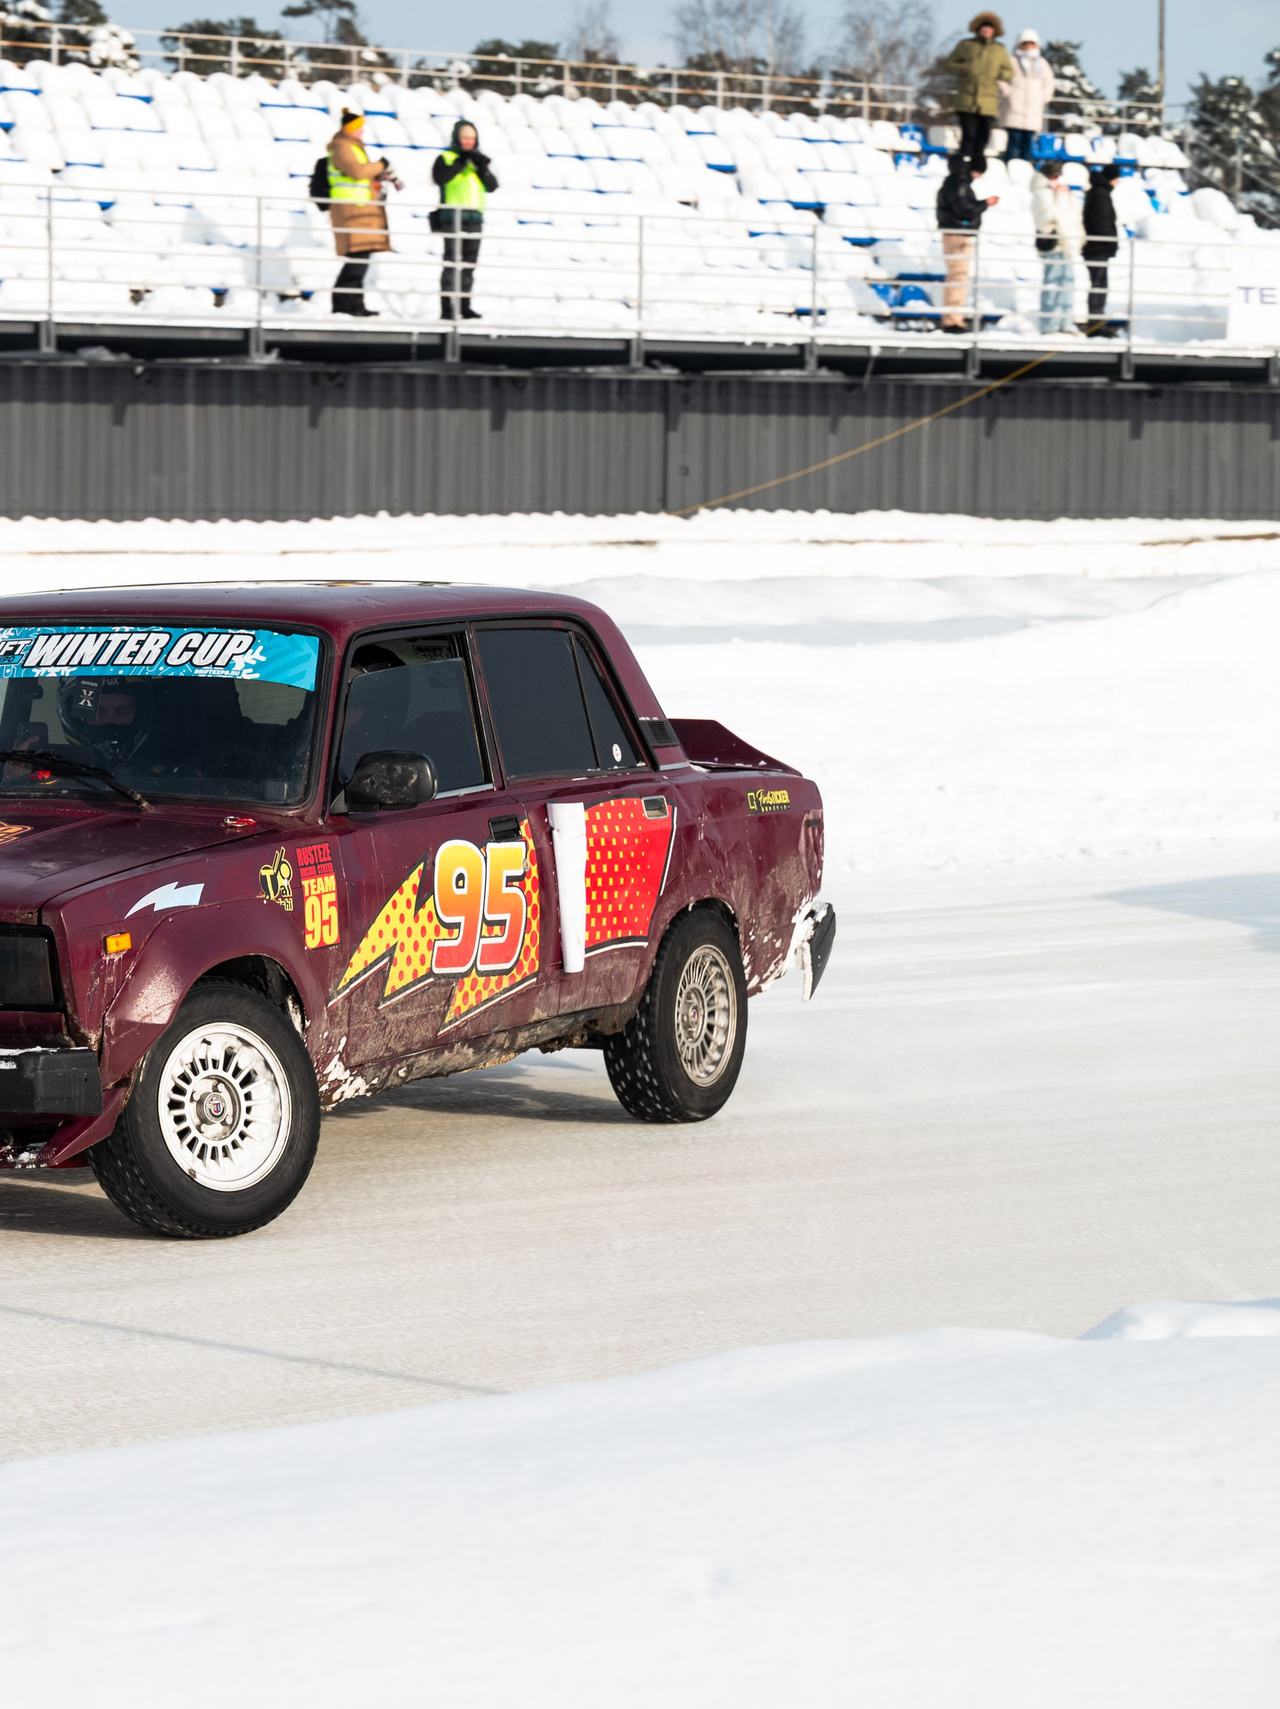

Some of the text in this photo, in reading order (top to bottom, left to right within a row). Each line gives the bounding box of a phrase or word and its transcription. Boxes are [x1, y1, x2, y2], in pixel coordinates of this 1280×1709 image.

[22, 632, 255, 667] WINTER CUP
[295, 842, 332, 867] RUSTEZE
[301, 874, 336, 897] TEAM
[304, 892, 339, 949] 95
[431, 839, 527, 977] 95
